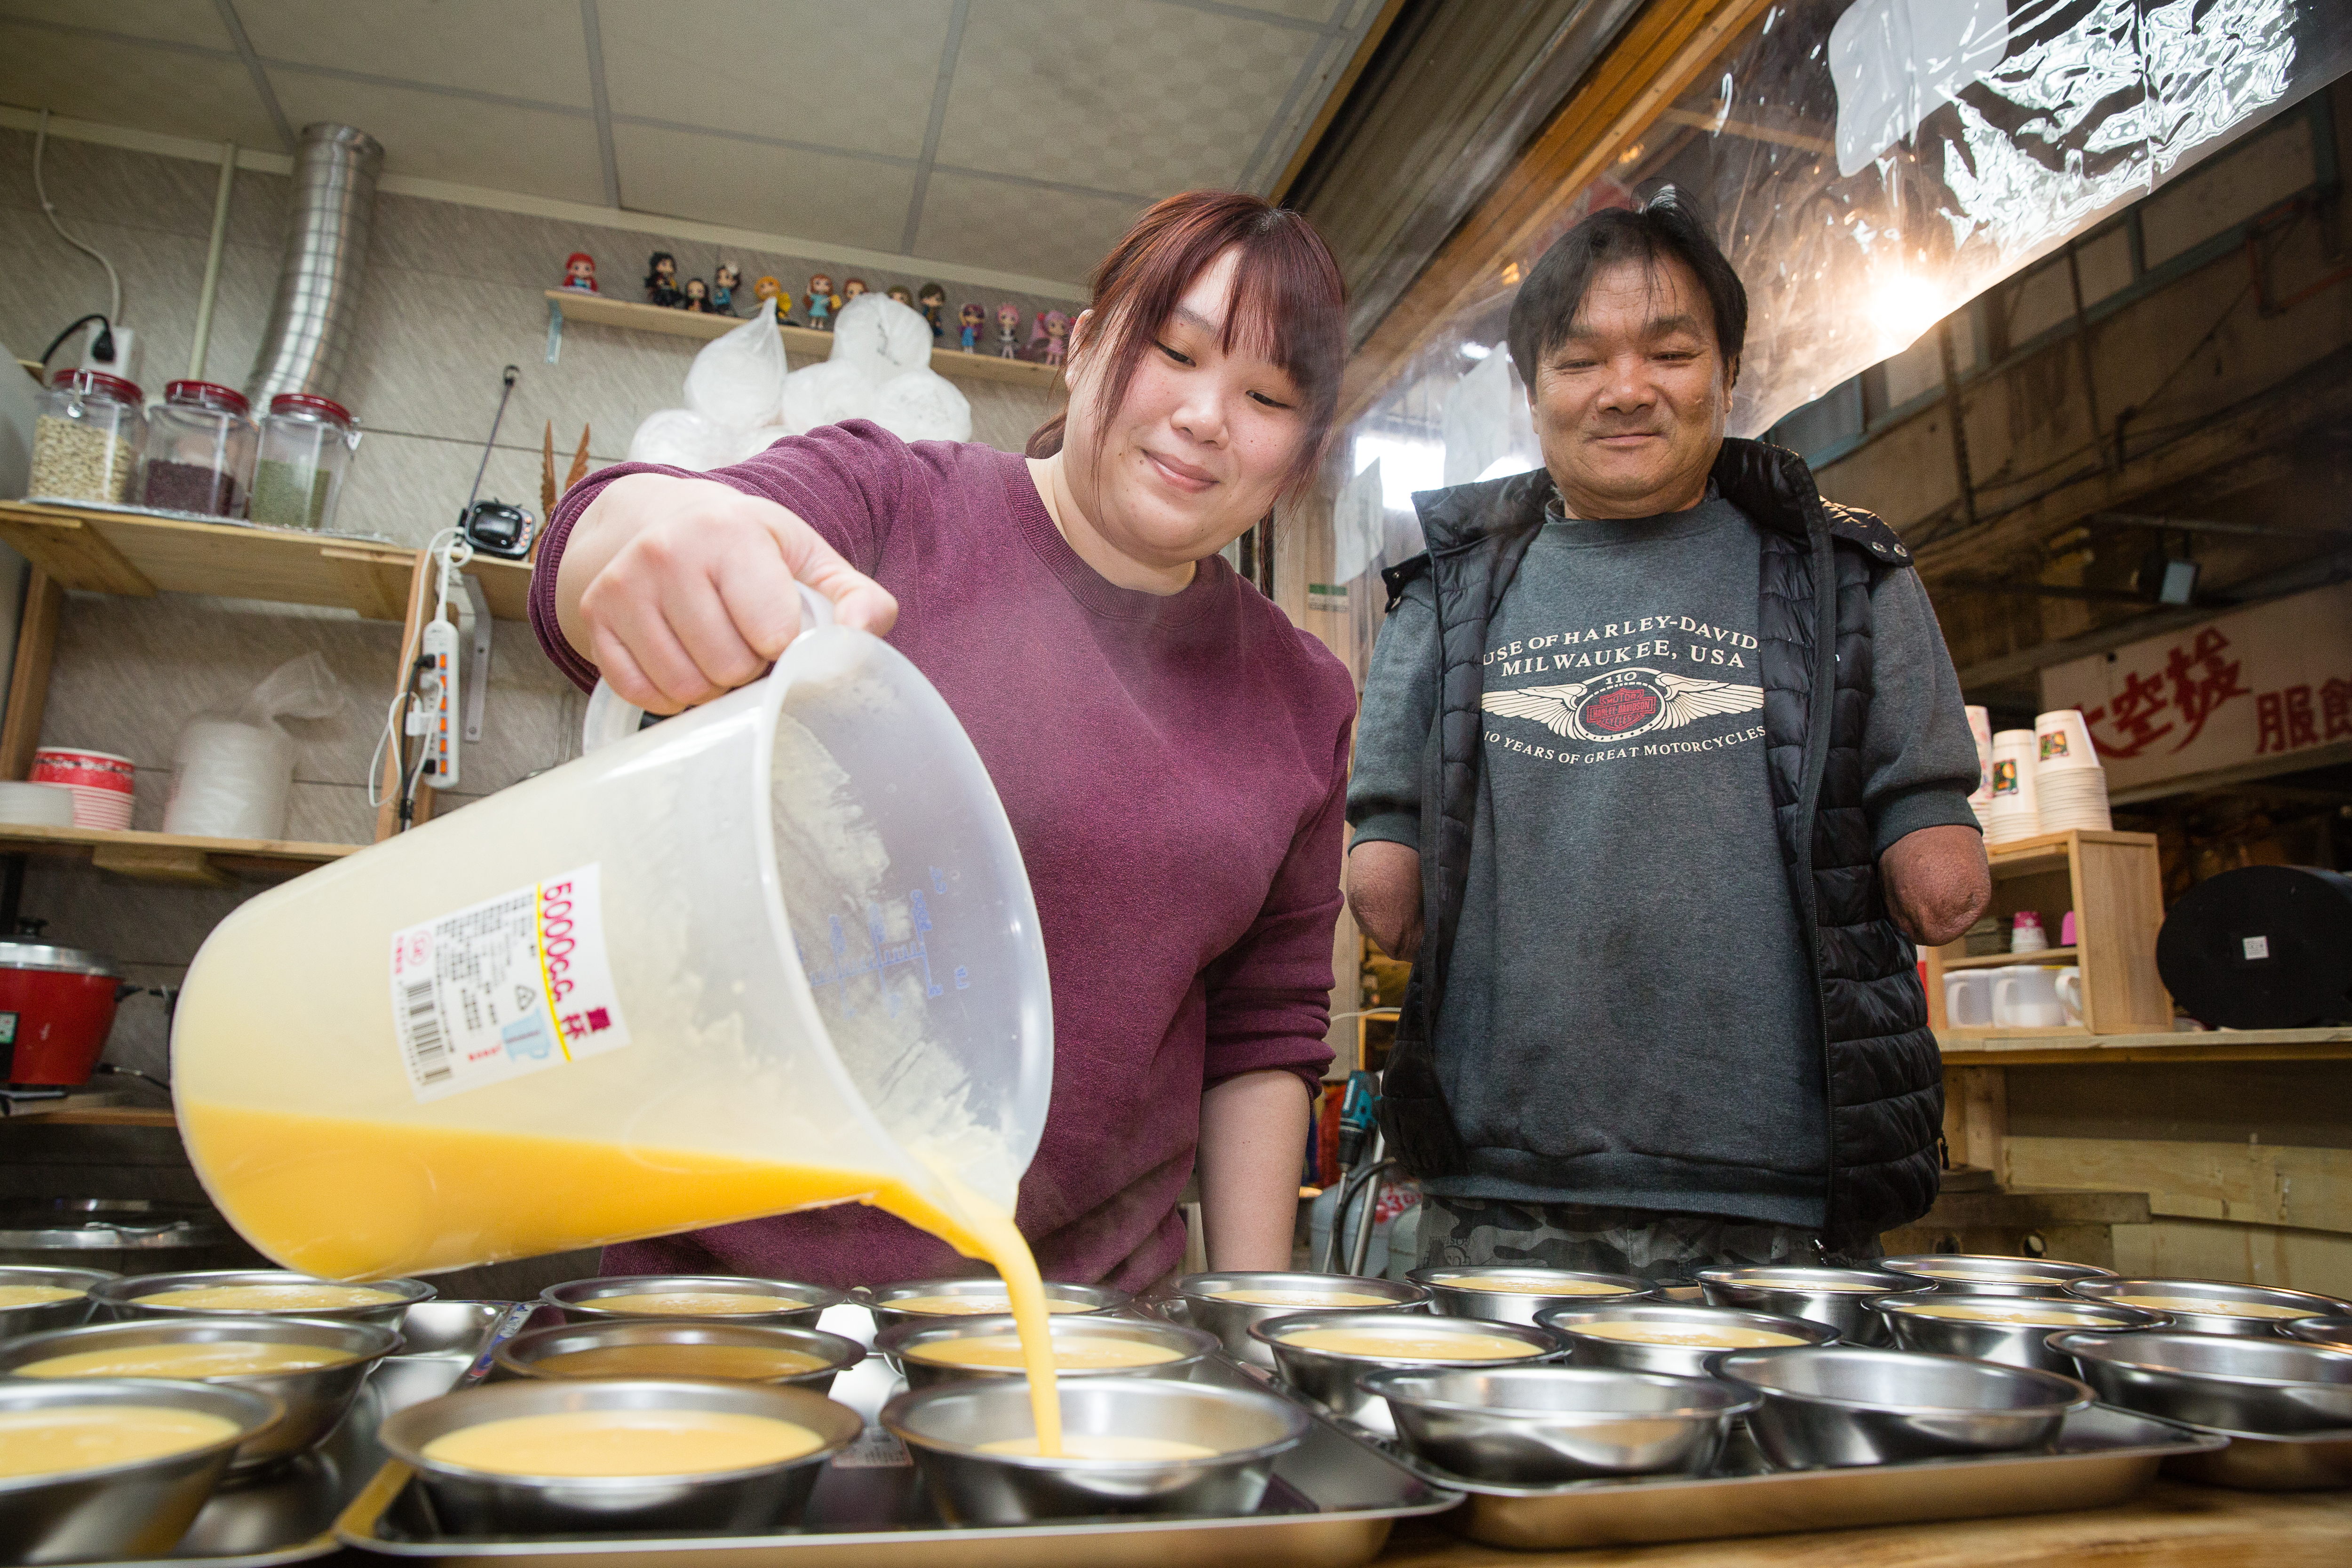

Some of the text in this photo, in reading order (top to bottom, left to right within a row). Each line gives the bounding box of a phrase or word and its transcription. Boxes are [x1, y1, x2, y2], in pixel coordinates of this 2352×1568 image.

[1528, 635, 1558, 649] OF
[1564, 615, 1760, 652] HARLEY-DAVID
[1501, 640, 1745, 677] MILWAUKEE, USA
[1605, 671, 1637, 685] 110
[1606, 693, 1637, 704] MOTOR
[1593, 700, 1650, 717] HARLEY-DAVIDSON
[1605, 715, 1633, 727] CYCLES
[1503, 737, 1555, 760] YEARS
[1558, 753, 1581, 764] OF
[1584, 747, 1639, 764] GREAT
[1644, 725, 1765, 756] MOTORCYCLES
